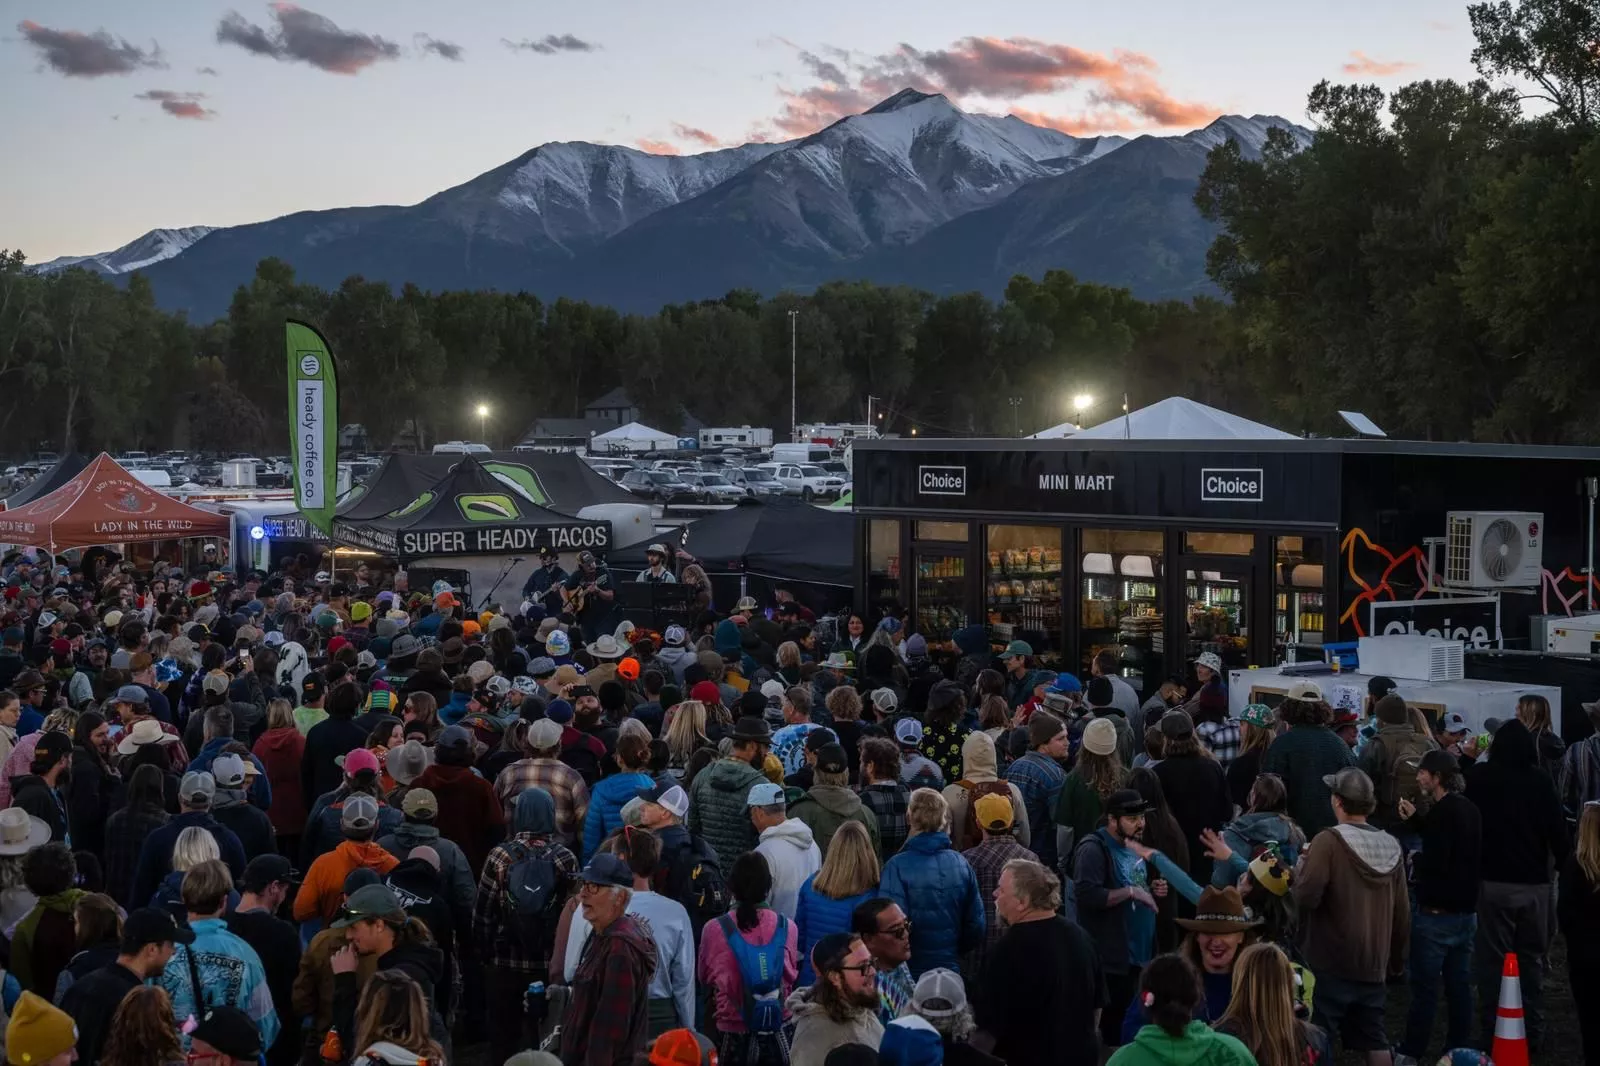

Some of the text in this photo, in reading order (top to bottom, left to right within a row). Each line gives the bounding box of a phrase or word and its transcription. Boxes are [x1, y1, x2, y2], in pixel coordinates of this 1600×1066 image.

[302, 387, 318, 502] heady coffee co.
[922, 472, 962, 490] Choice
[1039, 474, 1115, 491] MINI MART
[1206, 476, 1259, 495] Choice
[94, 519, 193, 533] LADY IN THE WILD
[264, 519, 284, 537] SUPER
[286, 519, 307, 538] HEADY
[403, 531, 466, 554] SUPER
[477, 528, 538, 550] HEADY
[548, 526, 608, 548] TACOS
[1528, 539, 1537, 548] LG
